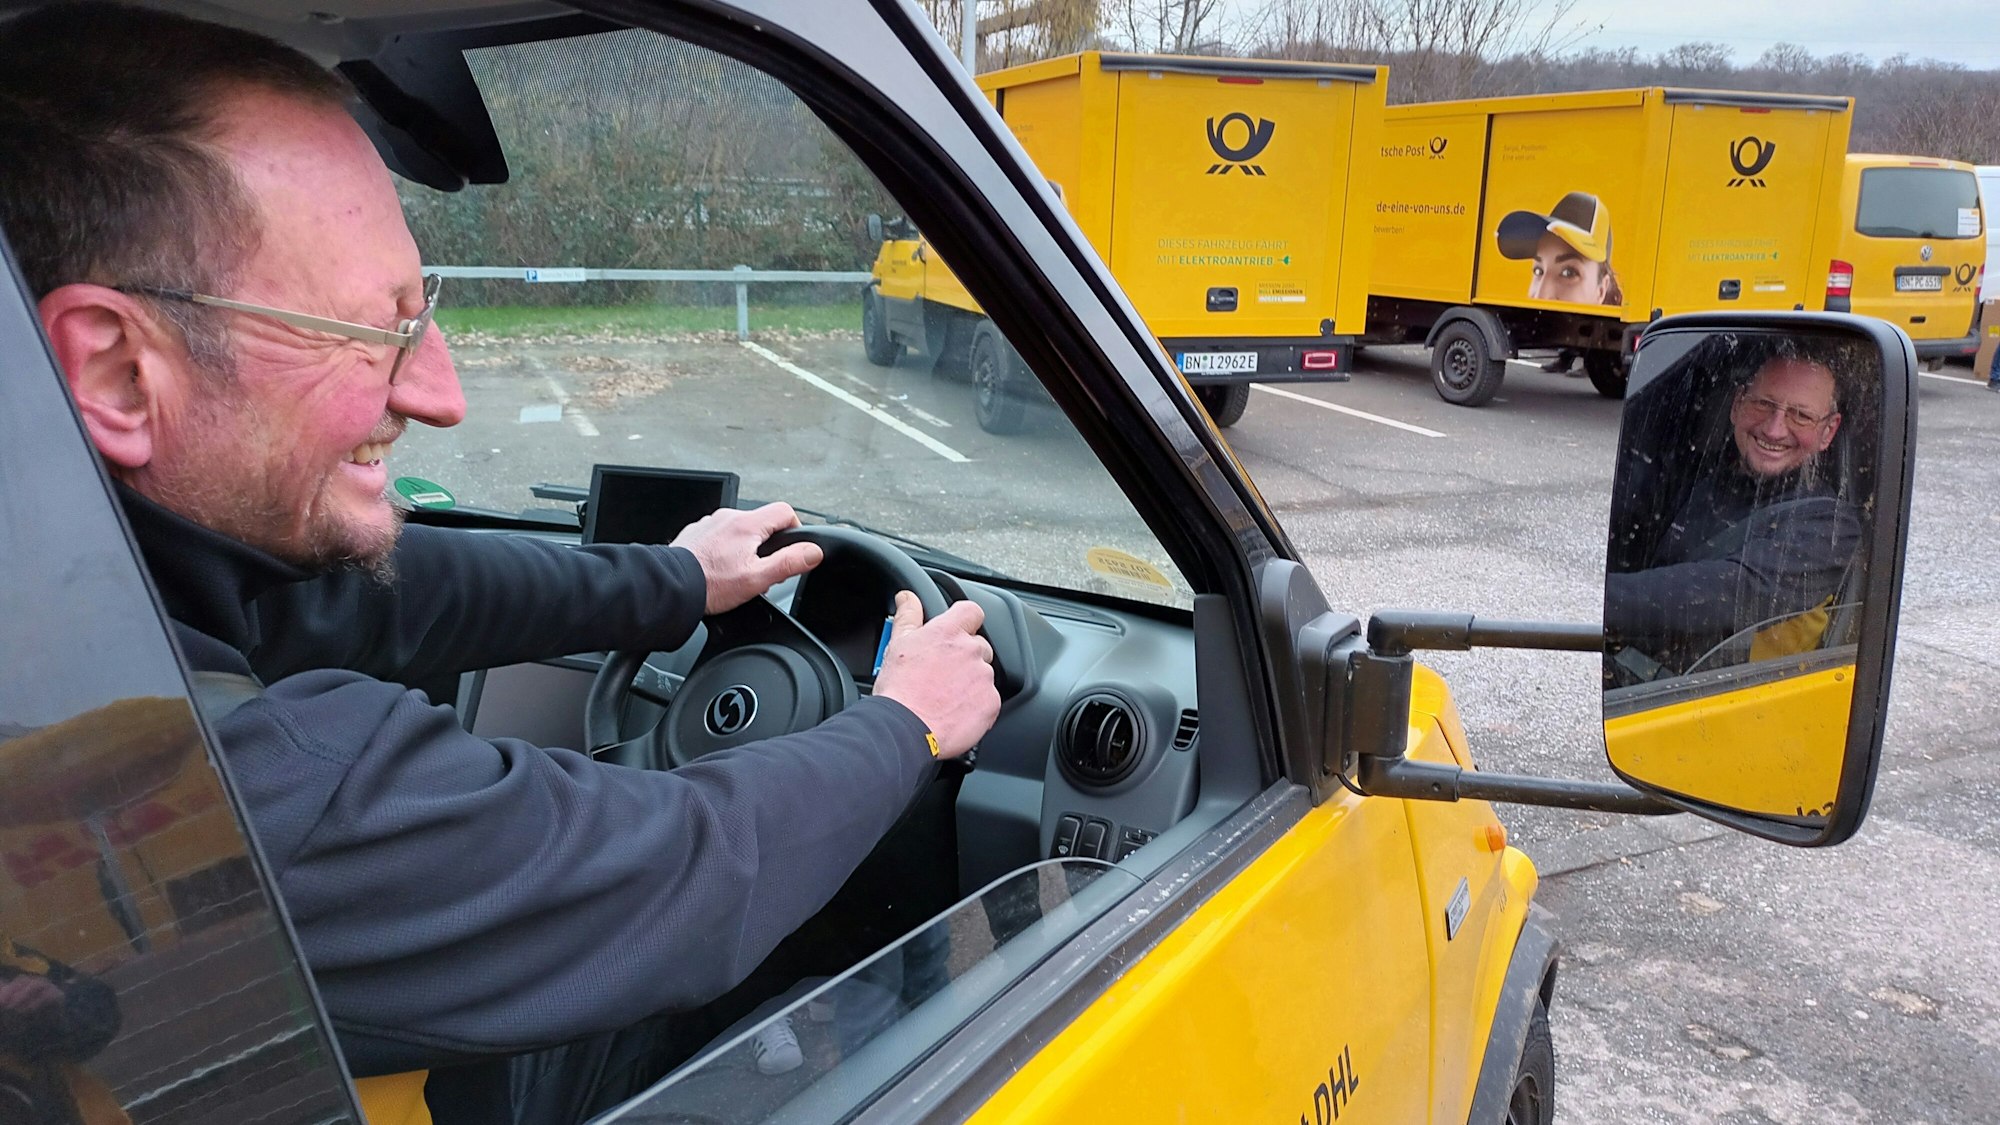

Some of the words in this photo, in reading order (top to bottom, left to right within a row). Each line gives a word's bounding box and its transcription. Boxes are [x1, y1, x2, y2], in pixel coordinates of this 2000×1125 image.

[1405, 145, 1425, 156] Post
[1376, 201, 1465, 215] de-eine-von-uns.de
[1158, 238, 1195, 249] DIESES
[1198, 239, 1253, 250] FAHRZEUG
[1157, 255, 1176, 265] MIT
[1179, 255, 1273, 266] ELEKTROANTRIEB
[1185, 355, 1200, 370] BN
[1313, 1042, 1360, 1125] DHL
